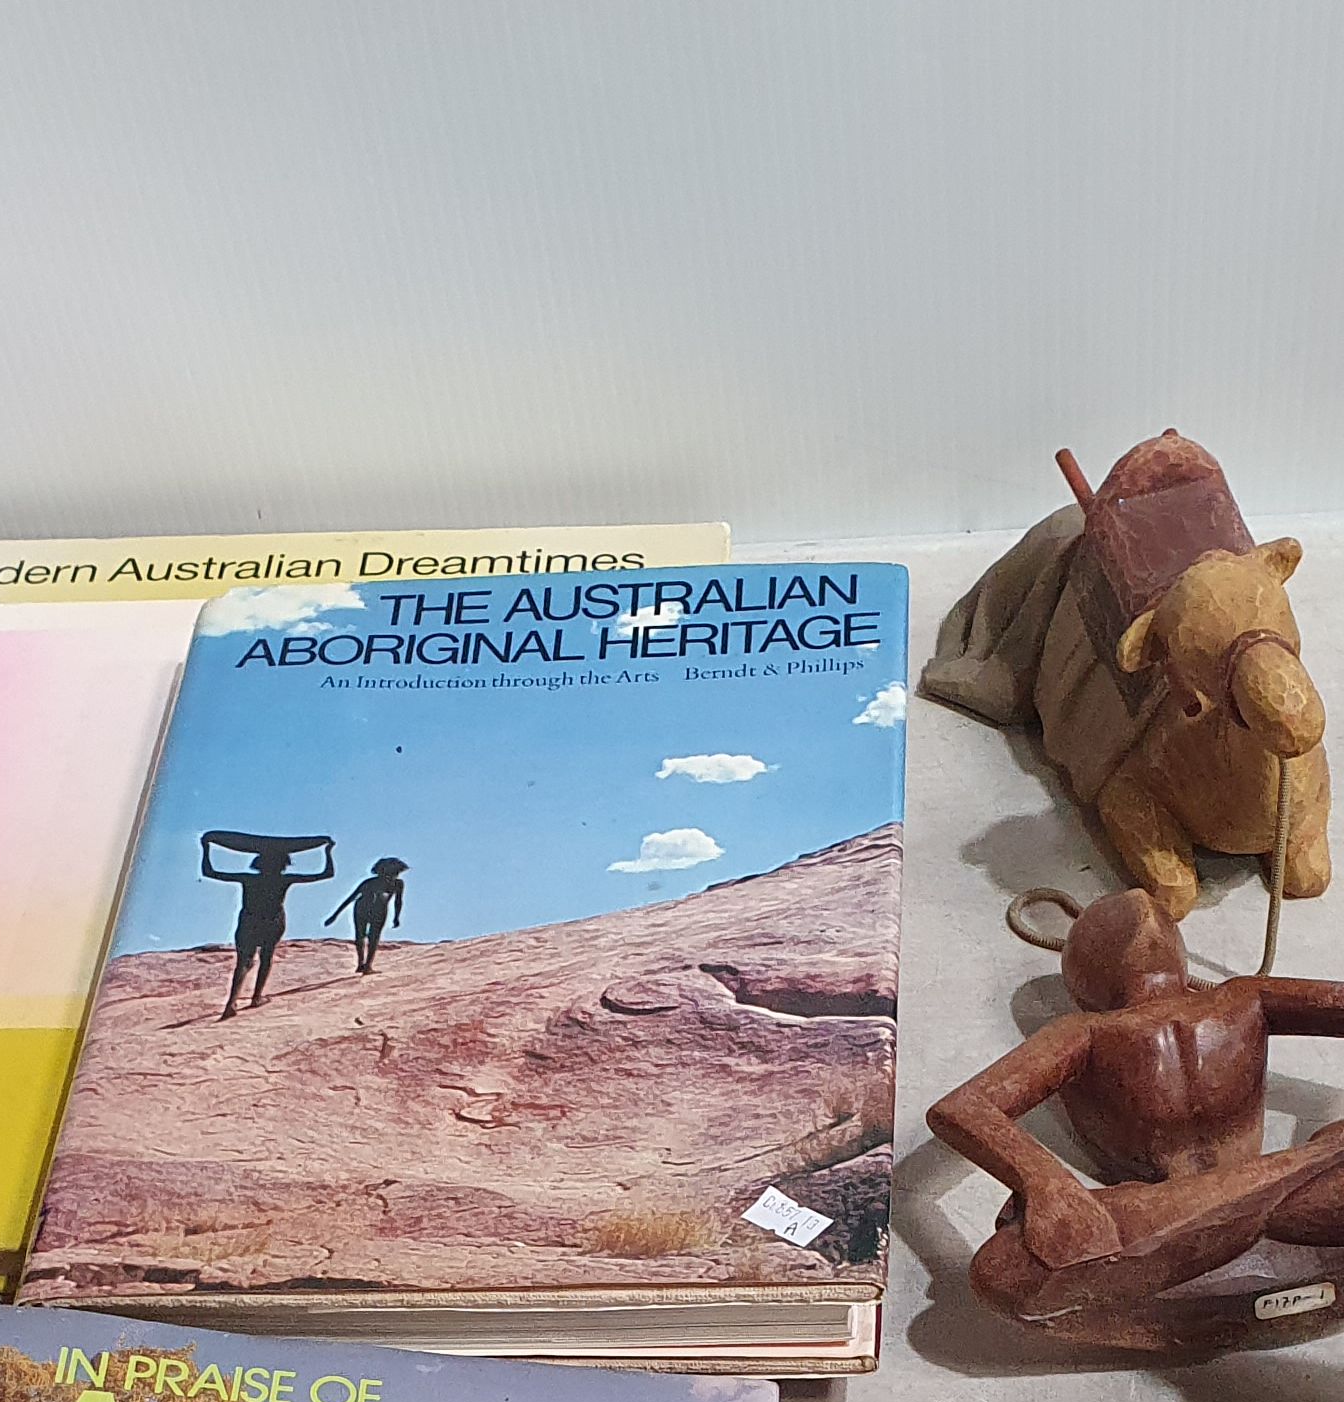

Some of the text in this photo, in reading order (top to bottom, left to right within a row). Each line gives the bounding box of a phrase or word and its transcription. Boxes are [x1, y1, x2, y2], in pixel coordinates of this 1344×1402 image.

[107, 553, 342, 582] Australian
[359, 547, 645, 579] Dreamtimes
[380, 575, 858, 627] THE AUSTRALIAN
[236, 612, 881, 669] ABORIGINAL HERITAGE
[321, 668, 661, 691] An Introduction through the Arts
[684, 656, 866, 682] Berndt & Phillips
[783, 1222, 799, 1237] A
[55, 1346, 108, 1388] IN
